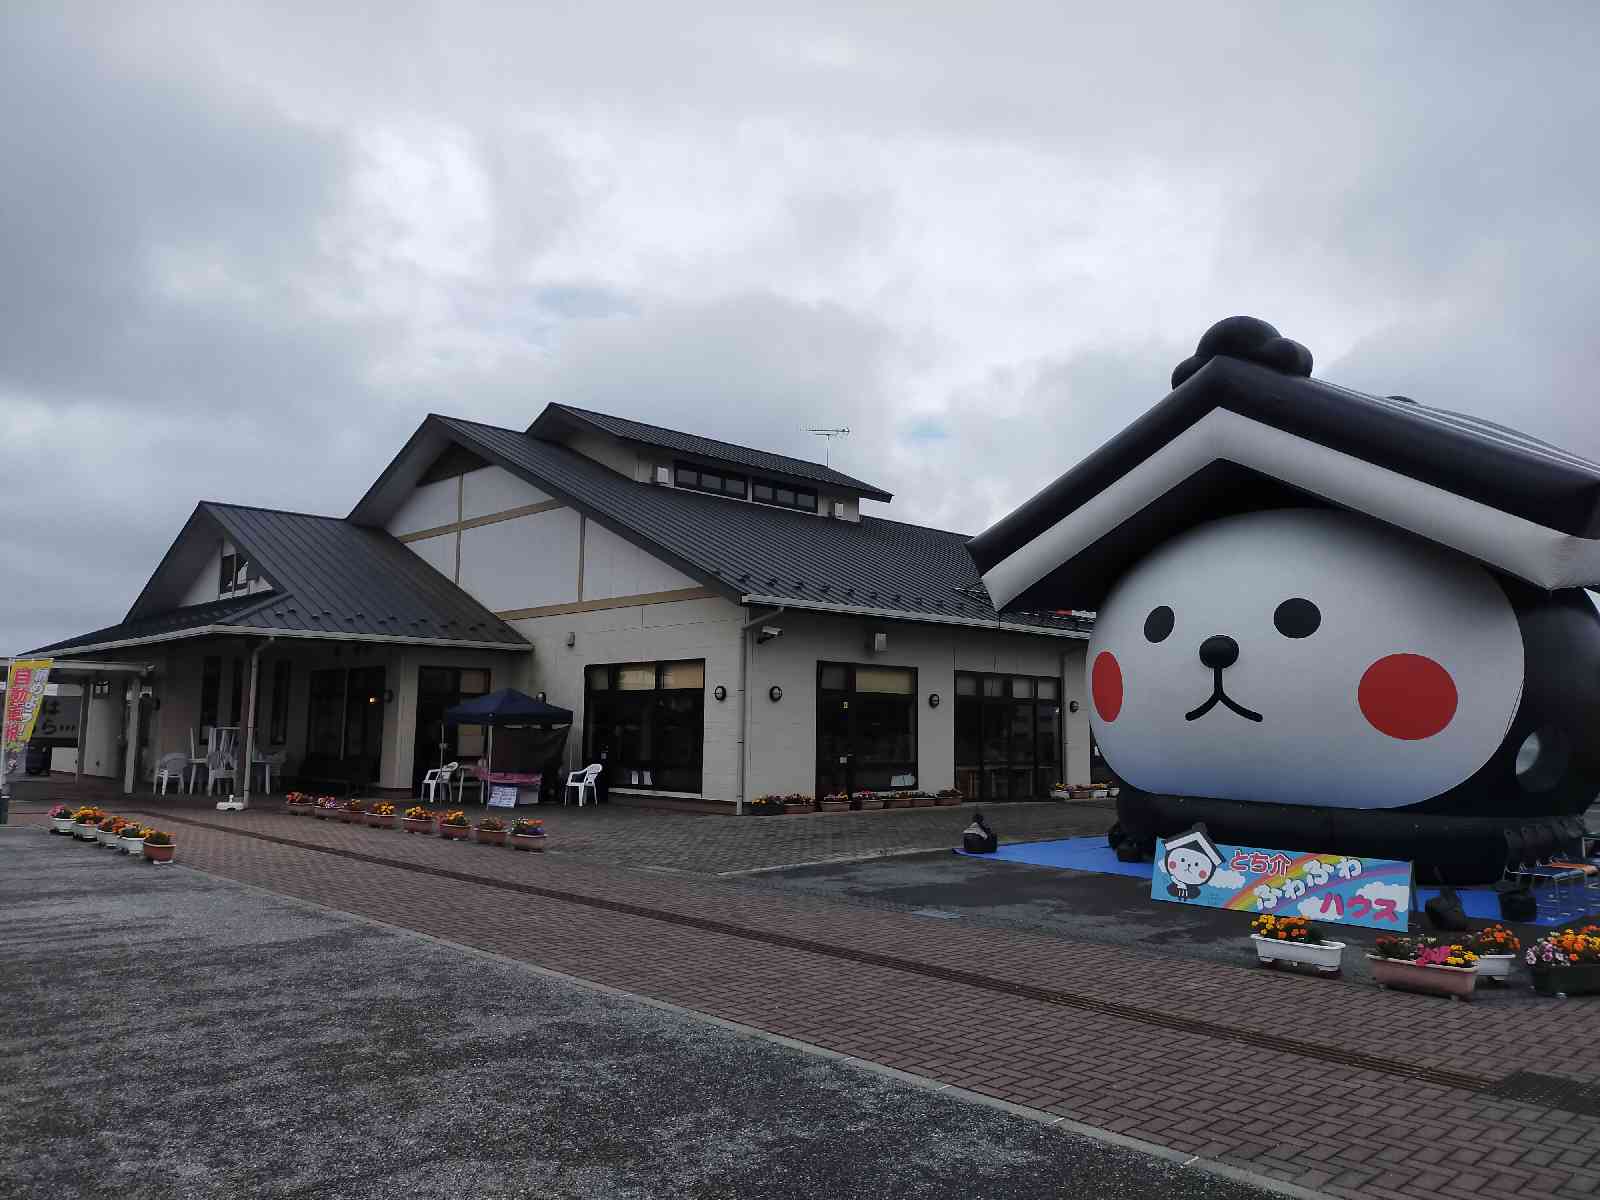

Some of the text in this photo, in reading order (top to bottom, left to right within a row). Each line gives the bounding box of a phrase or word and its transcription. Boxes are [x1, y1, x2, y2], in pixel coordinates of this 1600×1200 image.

[1230, 850, 1291, 878] とち介
[1253, 856, 1363, 911] ふわふわ
[1319, 893, 1399, 923] ハウス
